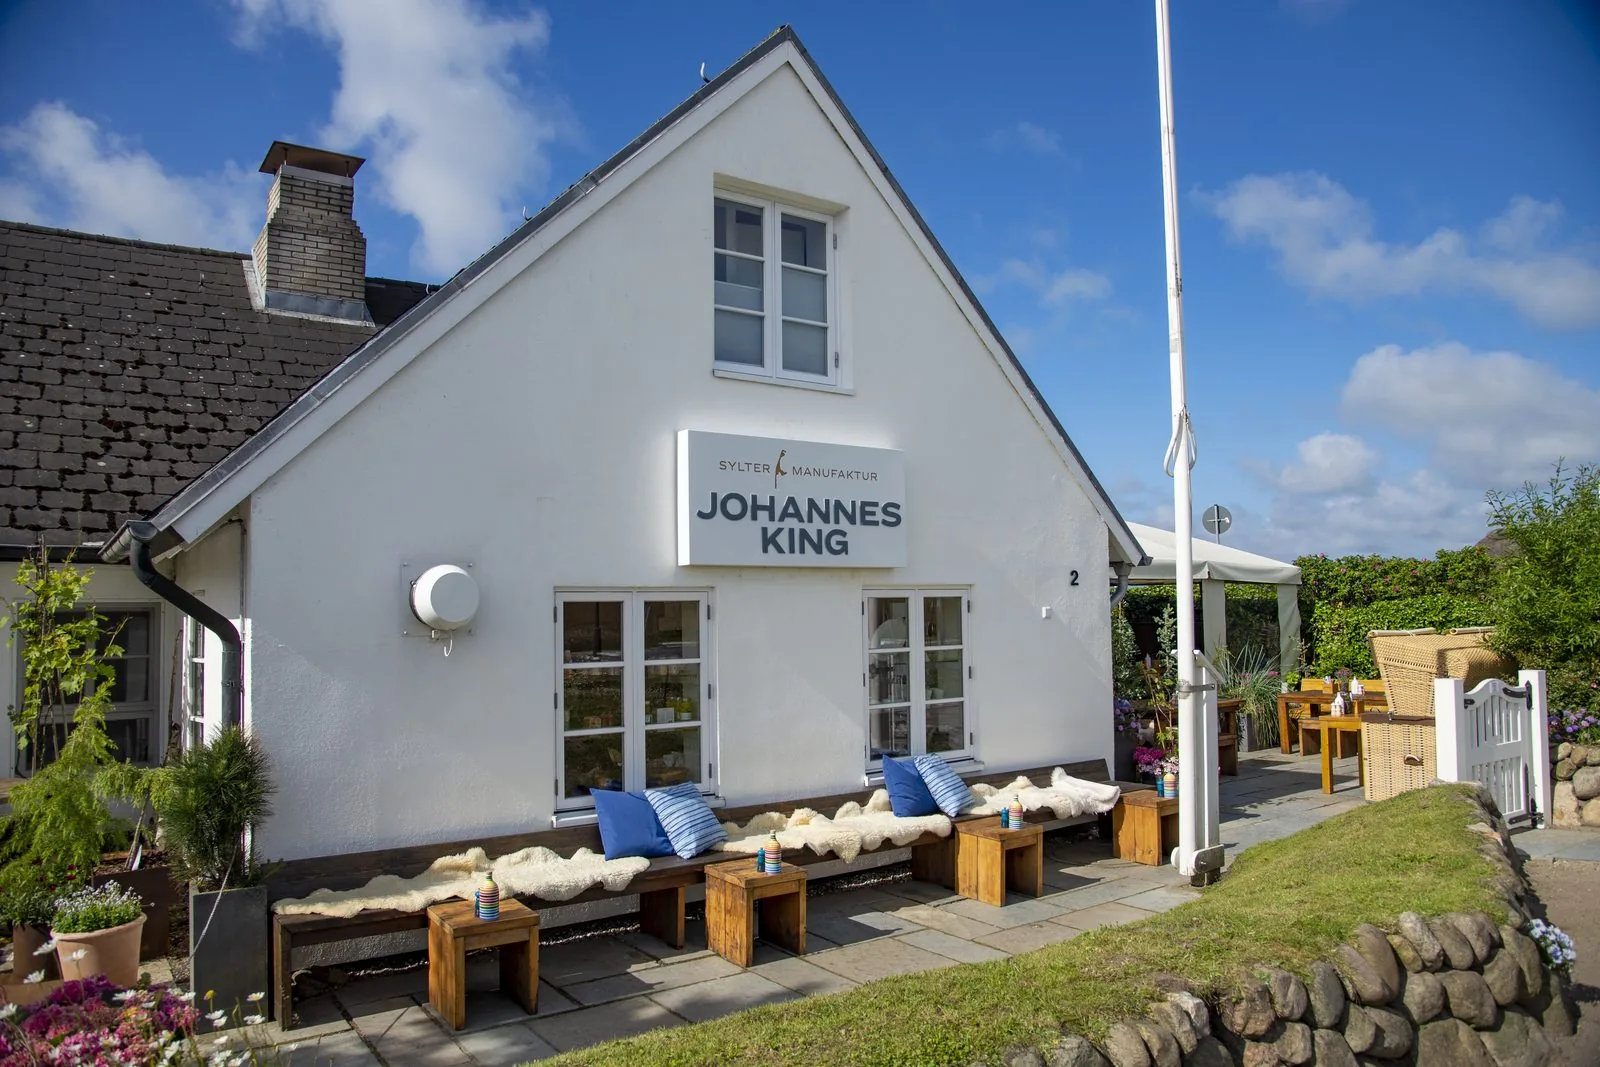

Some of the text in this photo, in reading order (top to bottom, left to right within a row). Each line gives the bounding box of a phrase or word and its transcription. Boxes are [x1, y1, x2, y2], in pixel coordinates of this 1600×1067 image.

[719, 460, 878, 481] SYLTER MANUFAKTUR
[696, 491, 902, 528] JOHANNES
[761, 526, 849, 556] KING
[1070, 569, 1080, 586] 2
